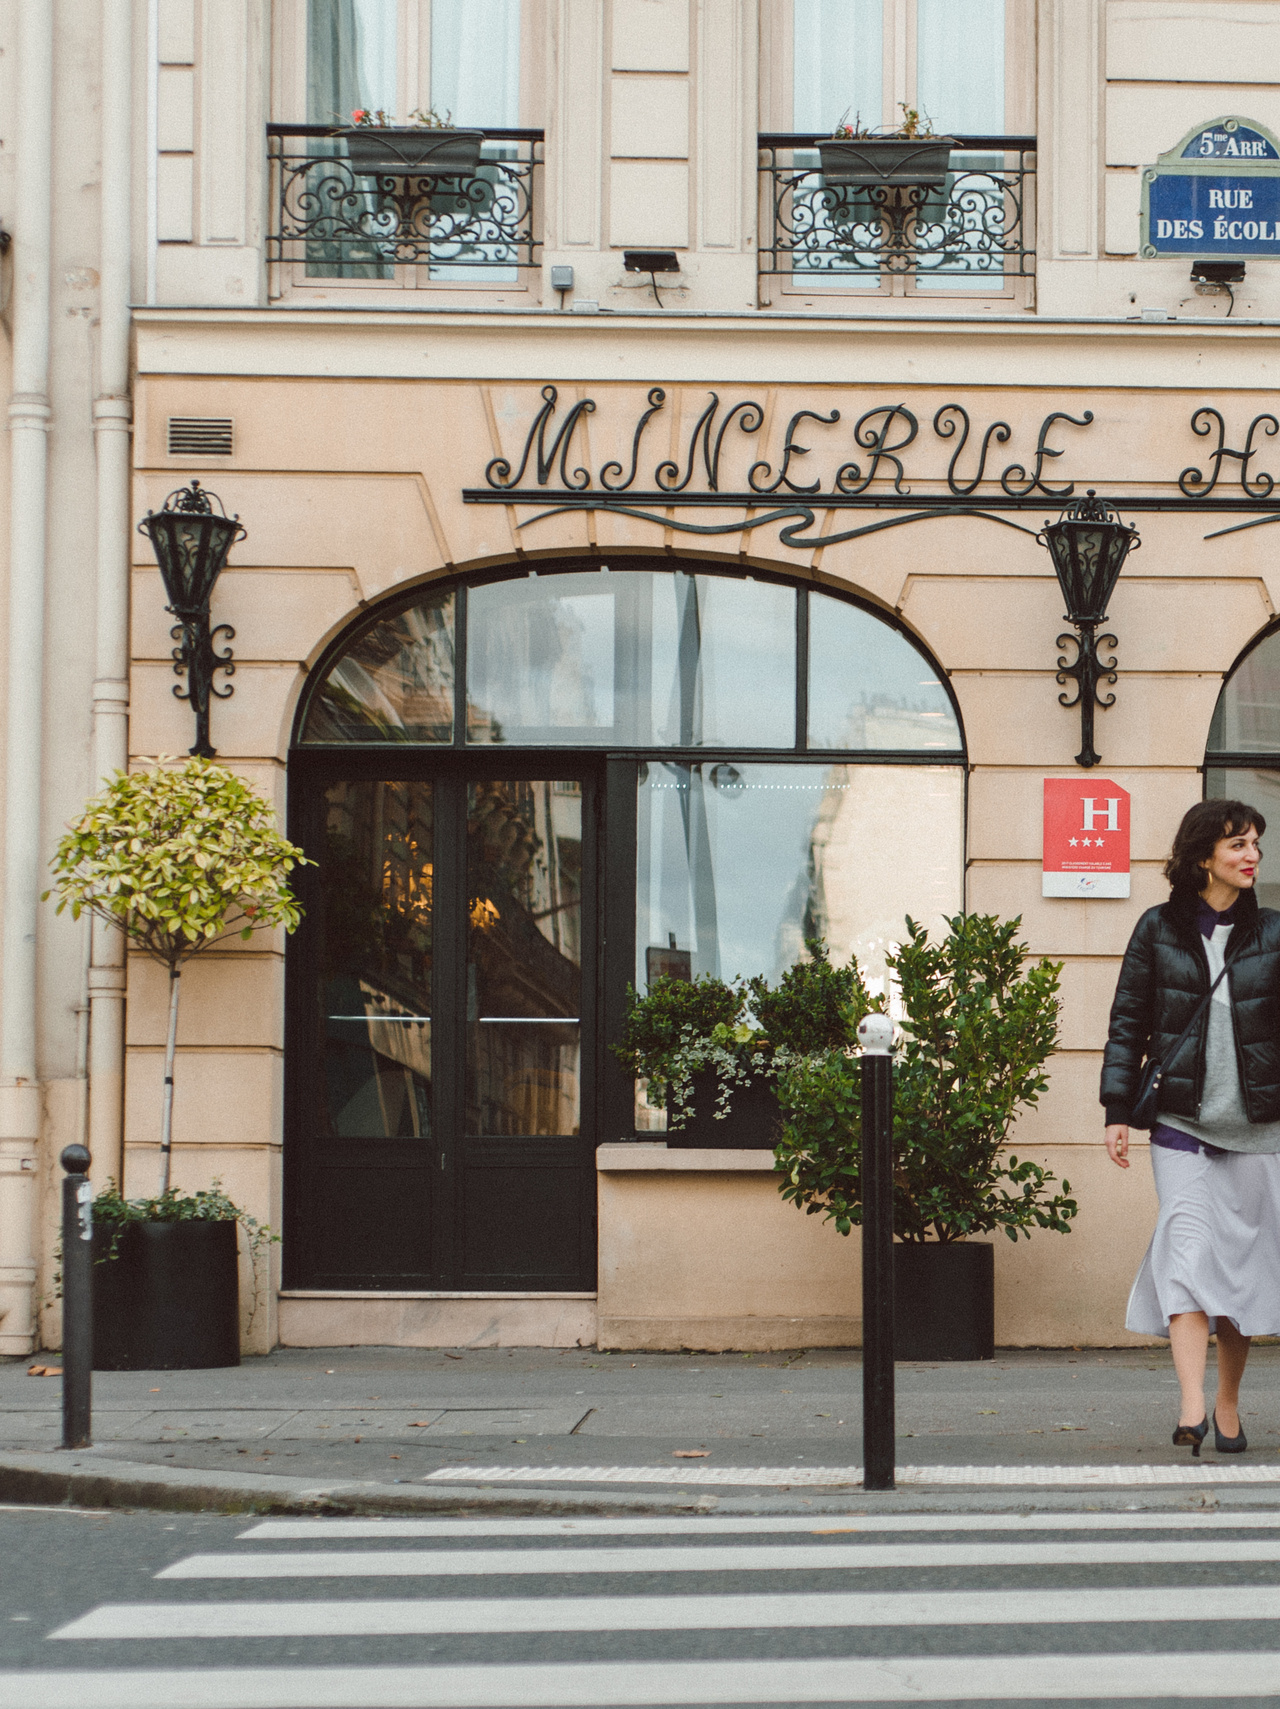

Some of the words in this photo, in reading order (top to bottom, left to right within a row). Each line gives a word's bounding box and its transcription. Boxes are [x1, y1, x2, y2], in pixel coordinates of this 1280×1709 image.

[1208, 189, 1253, 209] RUE
[1156, 219, 1204, 239] DES
[485, 384, 1094, 496] MINERVE
[1080, 797, 1122, 831] H
